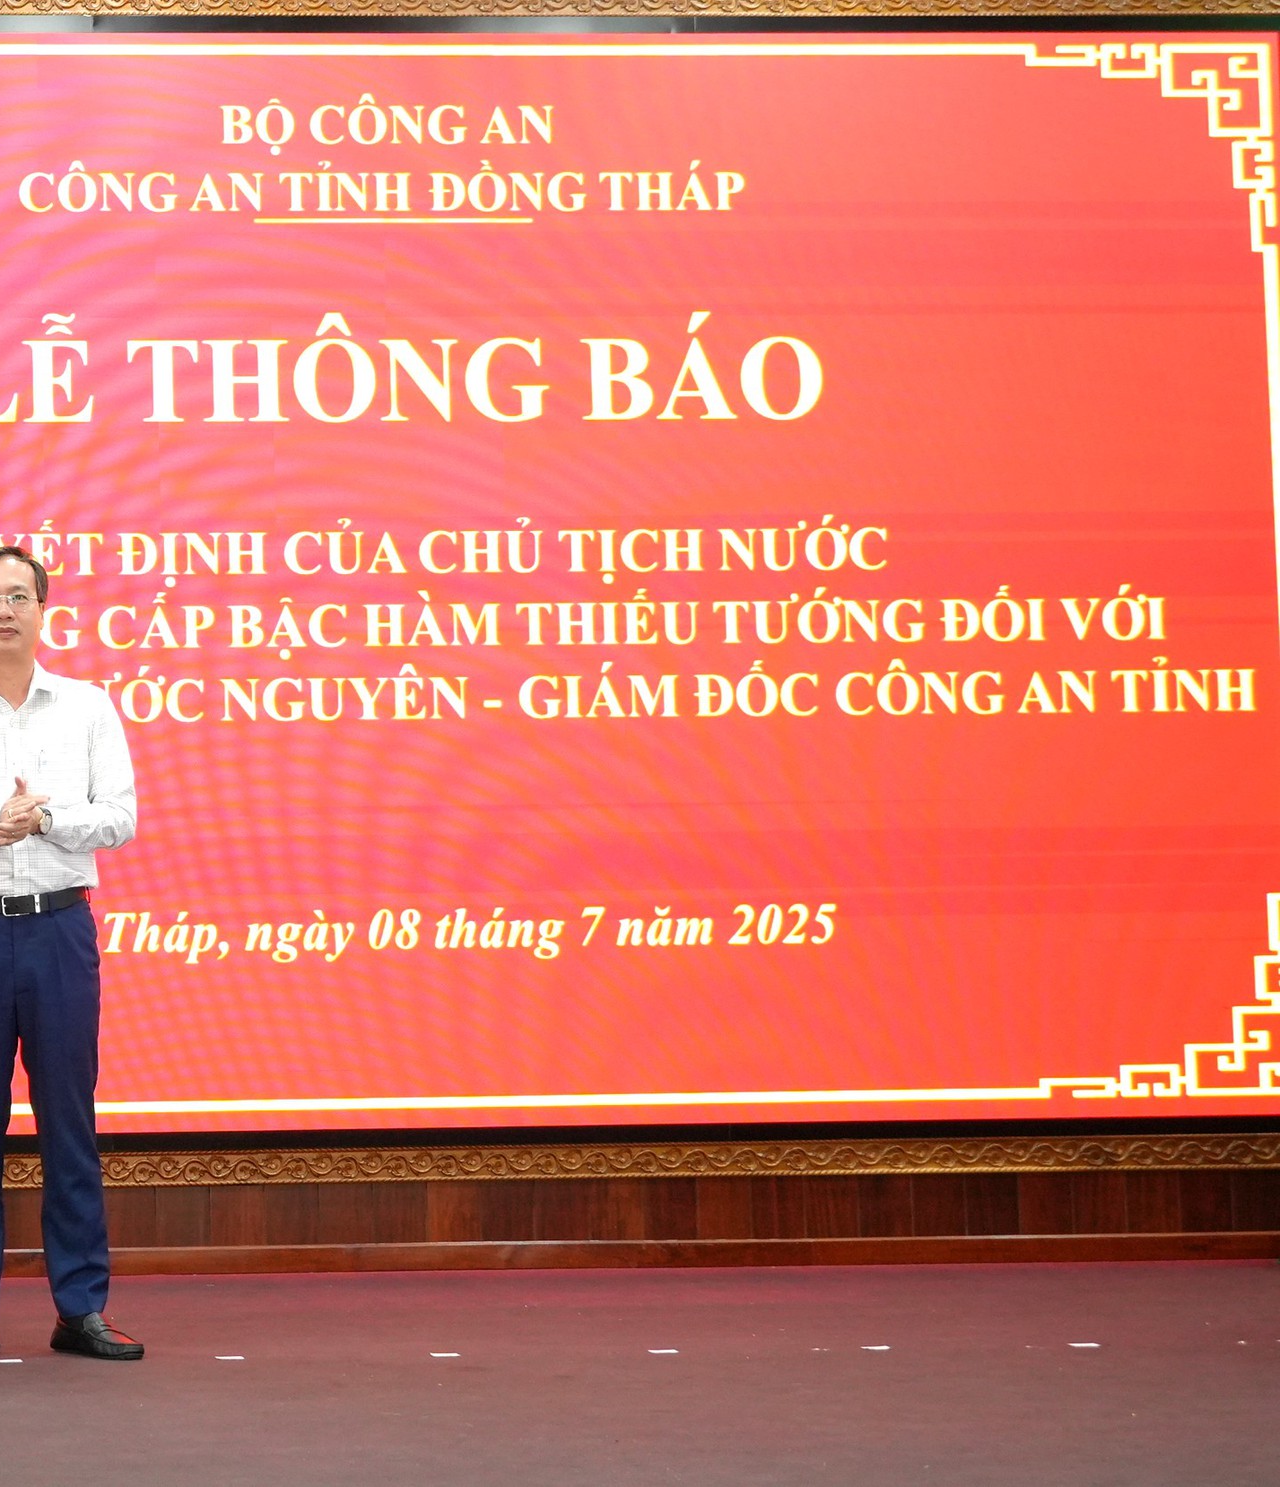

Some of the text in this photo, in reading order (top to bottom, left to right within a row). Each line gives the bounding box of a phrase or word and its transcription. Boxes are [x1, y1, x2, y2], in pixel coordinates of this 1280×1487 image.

[219, 93, 554, 156] BỘ CÔNG AN
[18, 158, 746, 213] CÔNG AN TỈNH ĐỒNG THÁP
[126, 312, 550, 424] THÔNG
[579, 310, 824, 421] BÁO
[116, 531, 267, 588] ĐỊNH
[283, 517, 408, 575] CỦA
[418, 516, 543, 575] CHỦ
[557, 528, 703, 585] TỊCH
[718, 514, 888, 572] NƯỚC
[97, 592, 215, 650] CẤP
[227, 597, 347, 661] BẬC
[363, 589, 501, 647] HÀM
[515, 587, 699, 646] THIẾU
[712, 587, 925, 644] TƯỚNG
[939, 585, 1045, 642] ĐỐI
[1059, 583, 1168, 642] VỚI
[219, 663, 468, 722] NGUYÊN
[518, 661, 679, 720] GIÁM
[693, 659, 819, 717] ĐỐC
[835, 658, 1005, 716] CÔNG
[1018, 670, 1096, 714] AN
[1110, 656, 1256, 713] TỈNH
[103, 903, 837, 963] Tháp, ngày 08 tháng 7 năm 2025
